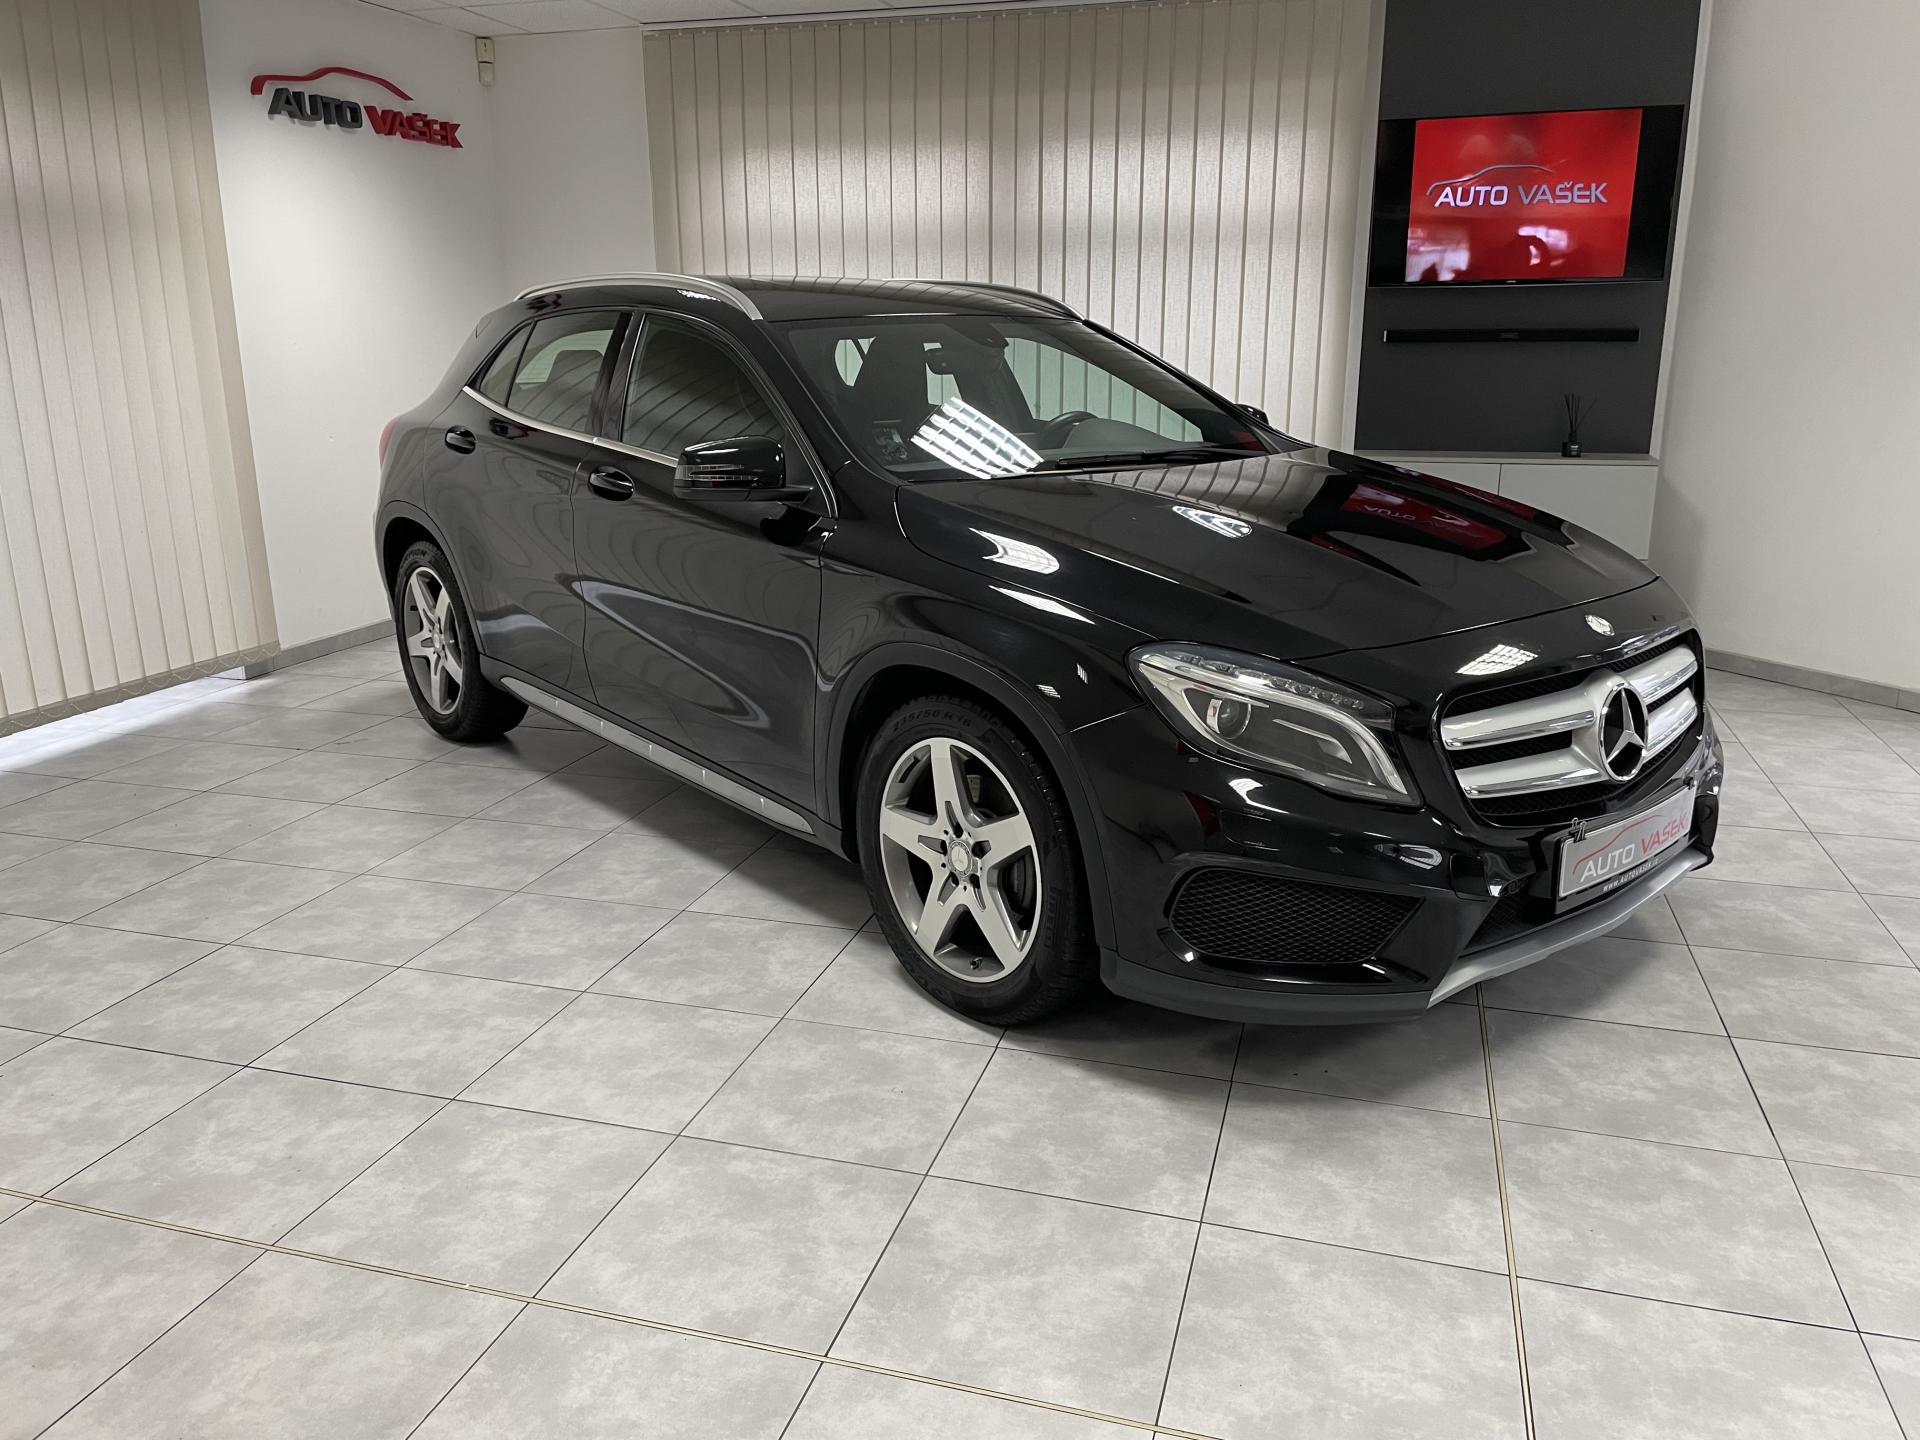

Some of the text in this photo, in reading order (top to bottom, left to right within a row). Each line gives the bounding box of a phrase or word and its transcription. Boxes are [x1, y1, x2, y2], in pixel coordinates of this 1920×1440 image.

[268, 87, 363, 129] AUTO
[1434, 181, 1608, 207] AUTO VAŠEK
[1580, 843, 1635, 882] AUTO
